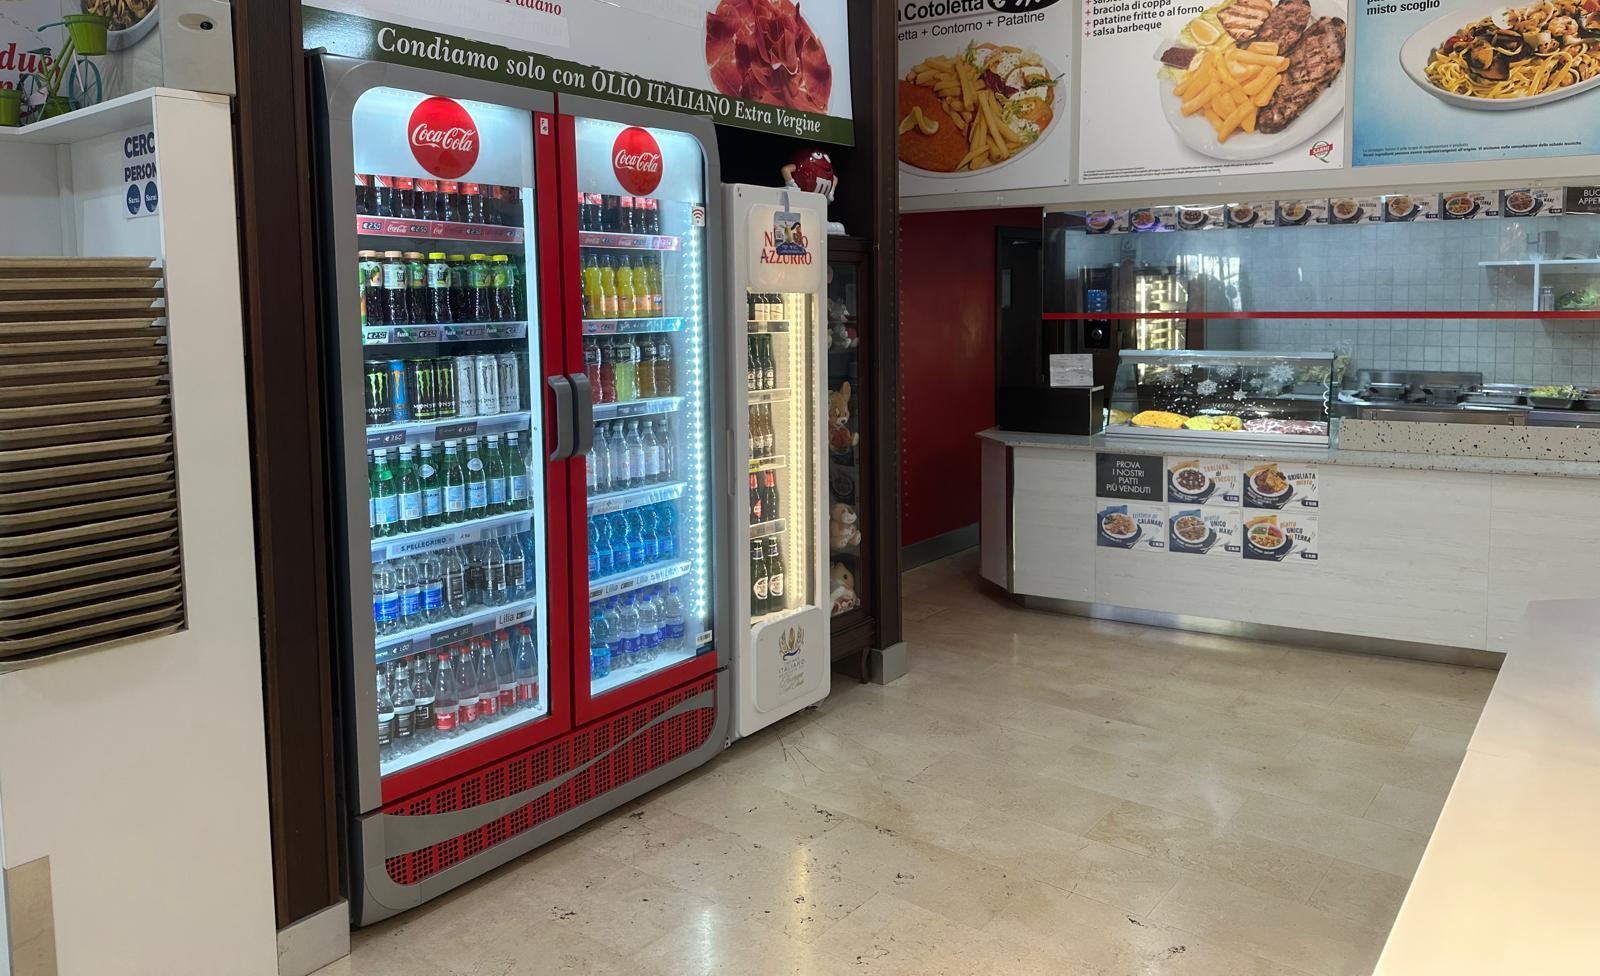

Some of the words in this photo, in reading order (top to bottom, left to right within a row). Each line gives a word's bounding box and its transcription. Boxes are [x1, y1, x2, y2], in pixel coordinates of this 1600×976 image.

[904, 0, 984, 20] Cotoletta
[1093, 3, 1129, 15] braciola
[1131, 0, 1140, 10] di
[1142, 0, 1171, 9] coppa
[1367, 4, 1397, 15] misto
[1400, 0, 1440, 12] scoglio
[931, 21, 982, 36] Contorno
[997, 12, 1045, 27] Patatine
[1093, 14, 1132, 27] patatine
[1134, 8, 1157, 21] fritte
[1167, 7, 1175, 17] al
[1177, 5, 1204, 16] forno
[1093, 26, 1115, 37] salsa
[1117, 21, 1162, 34] barbeque
[377, 27, 499, 71] Condiamo
[507, 56, 545, 80] solo
[553, 67, 586, 89] con
[591, 71, 641, 99] OLIO
[647, 82, 730, 116] ITALIANO
[735, 100, 772, 125] Extra
[775, 108, 821, 135] Vergine
[412, 123, 476, 151] Coca-Cola
[615, 149, 660, 173] Coca-Cola
[1116, 460, 1141, 469] PROVA
[1116, 469, 1145, 478] NOSTRI
[1118, 477, 1139, 485] PIATTI
[1119, 484, 1151, 494] VENDUTI
